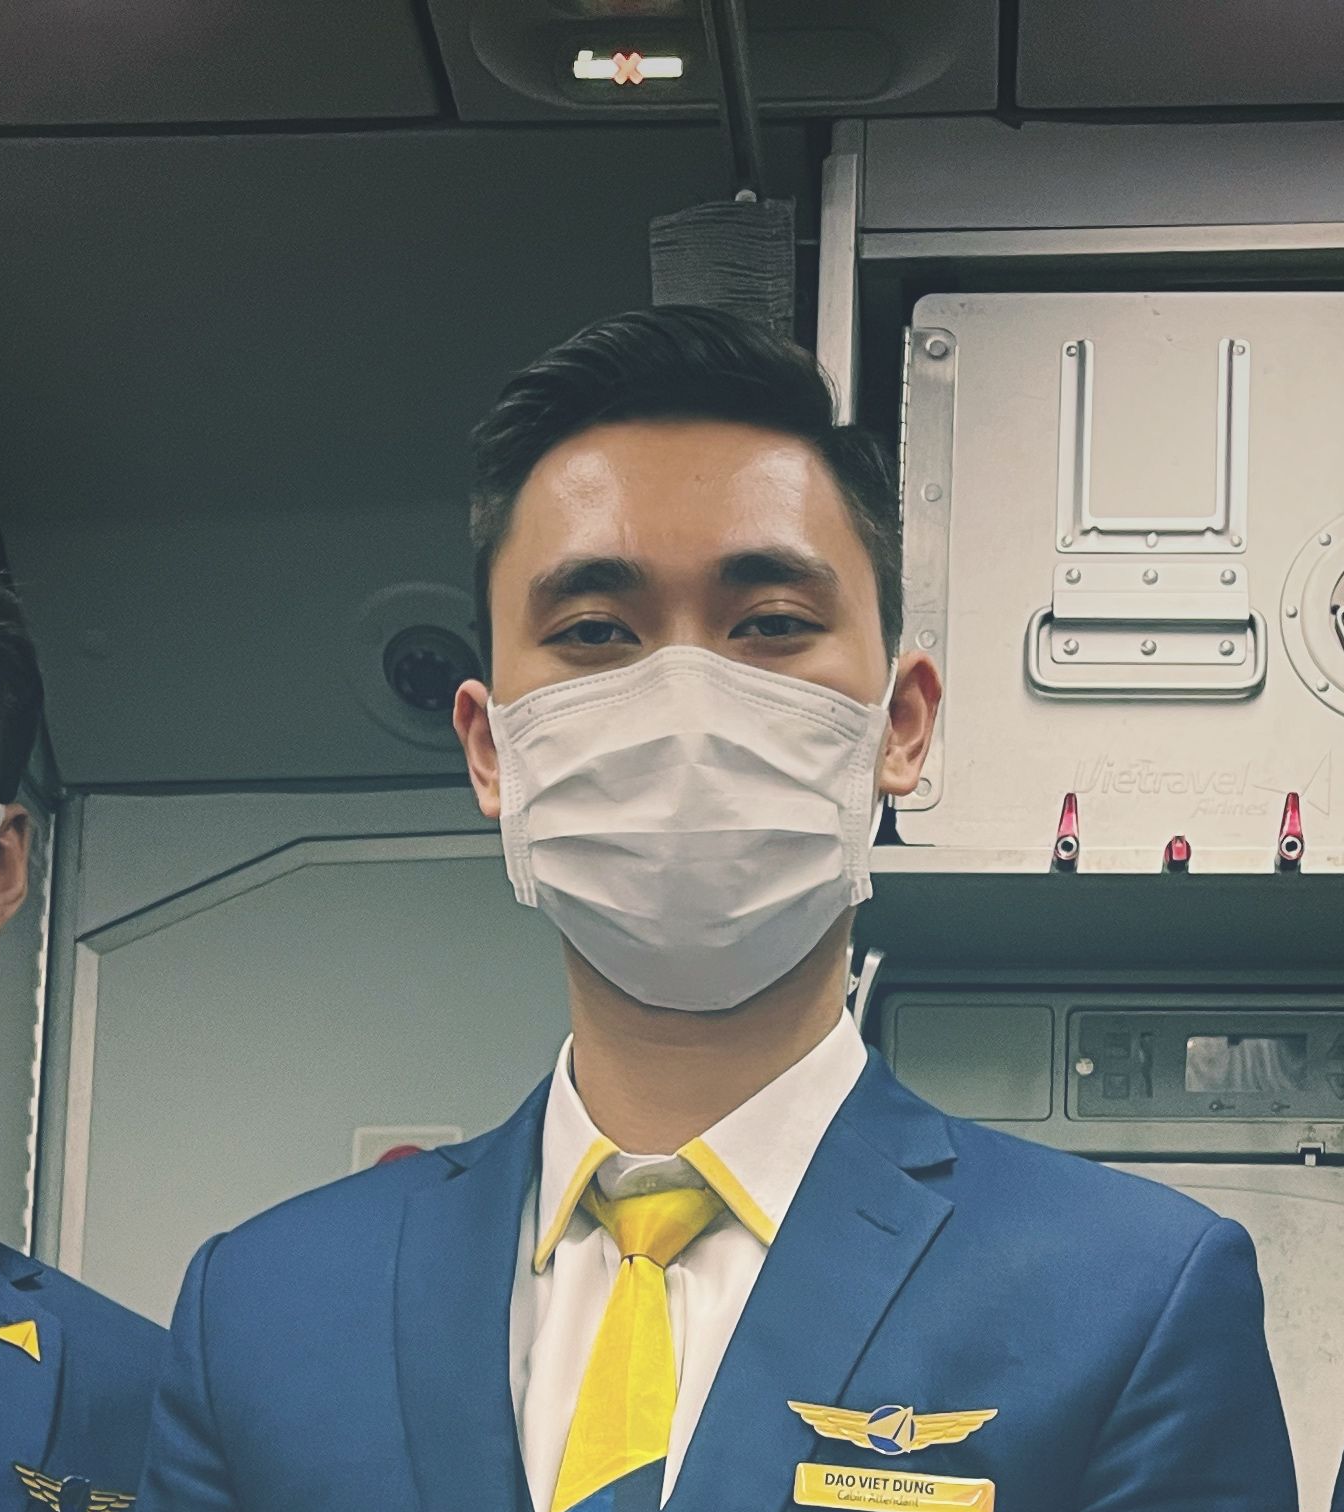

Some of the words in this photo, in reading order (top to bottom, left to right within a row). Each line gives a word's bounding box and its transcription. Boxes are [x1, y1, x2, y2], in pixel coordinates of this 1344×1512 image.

[825, 1473, 856, 1488] DAO
[859, 1476, 890, 1491] VIET
[893, 1479, 935, 1495] DUNG
[837, 1490, 867, 1502] Cabin
[868, 1492, 920, 1508] Attendant
